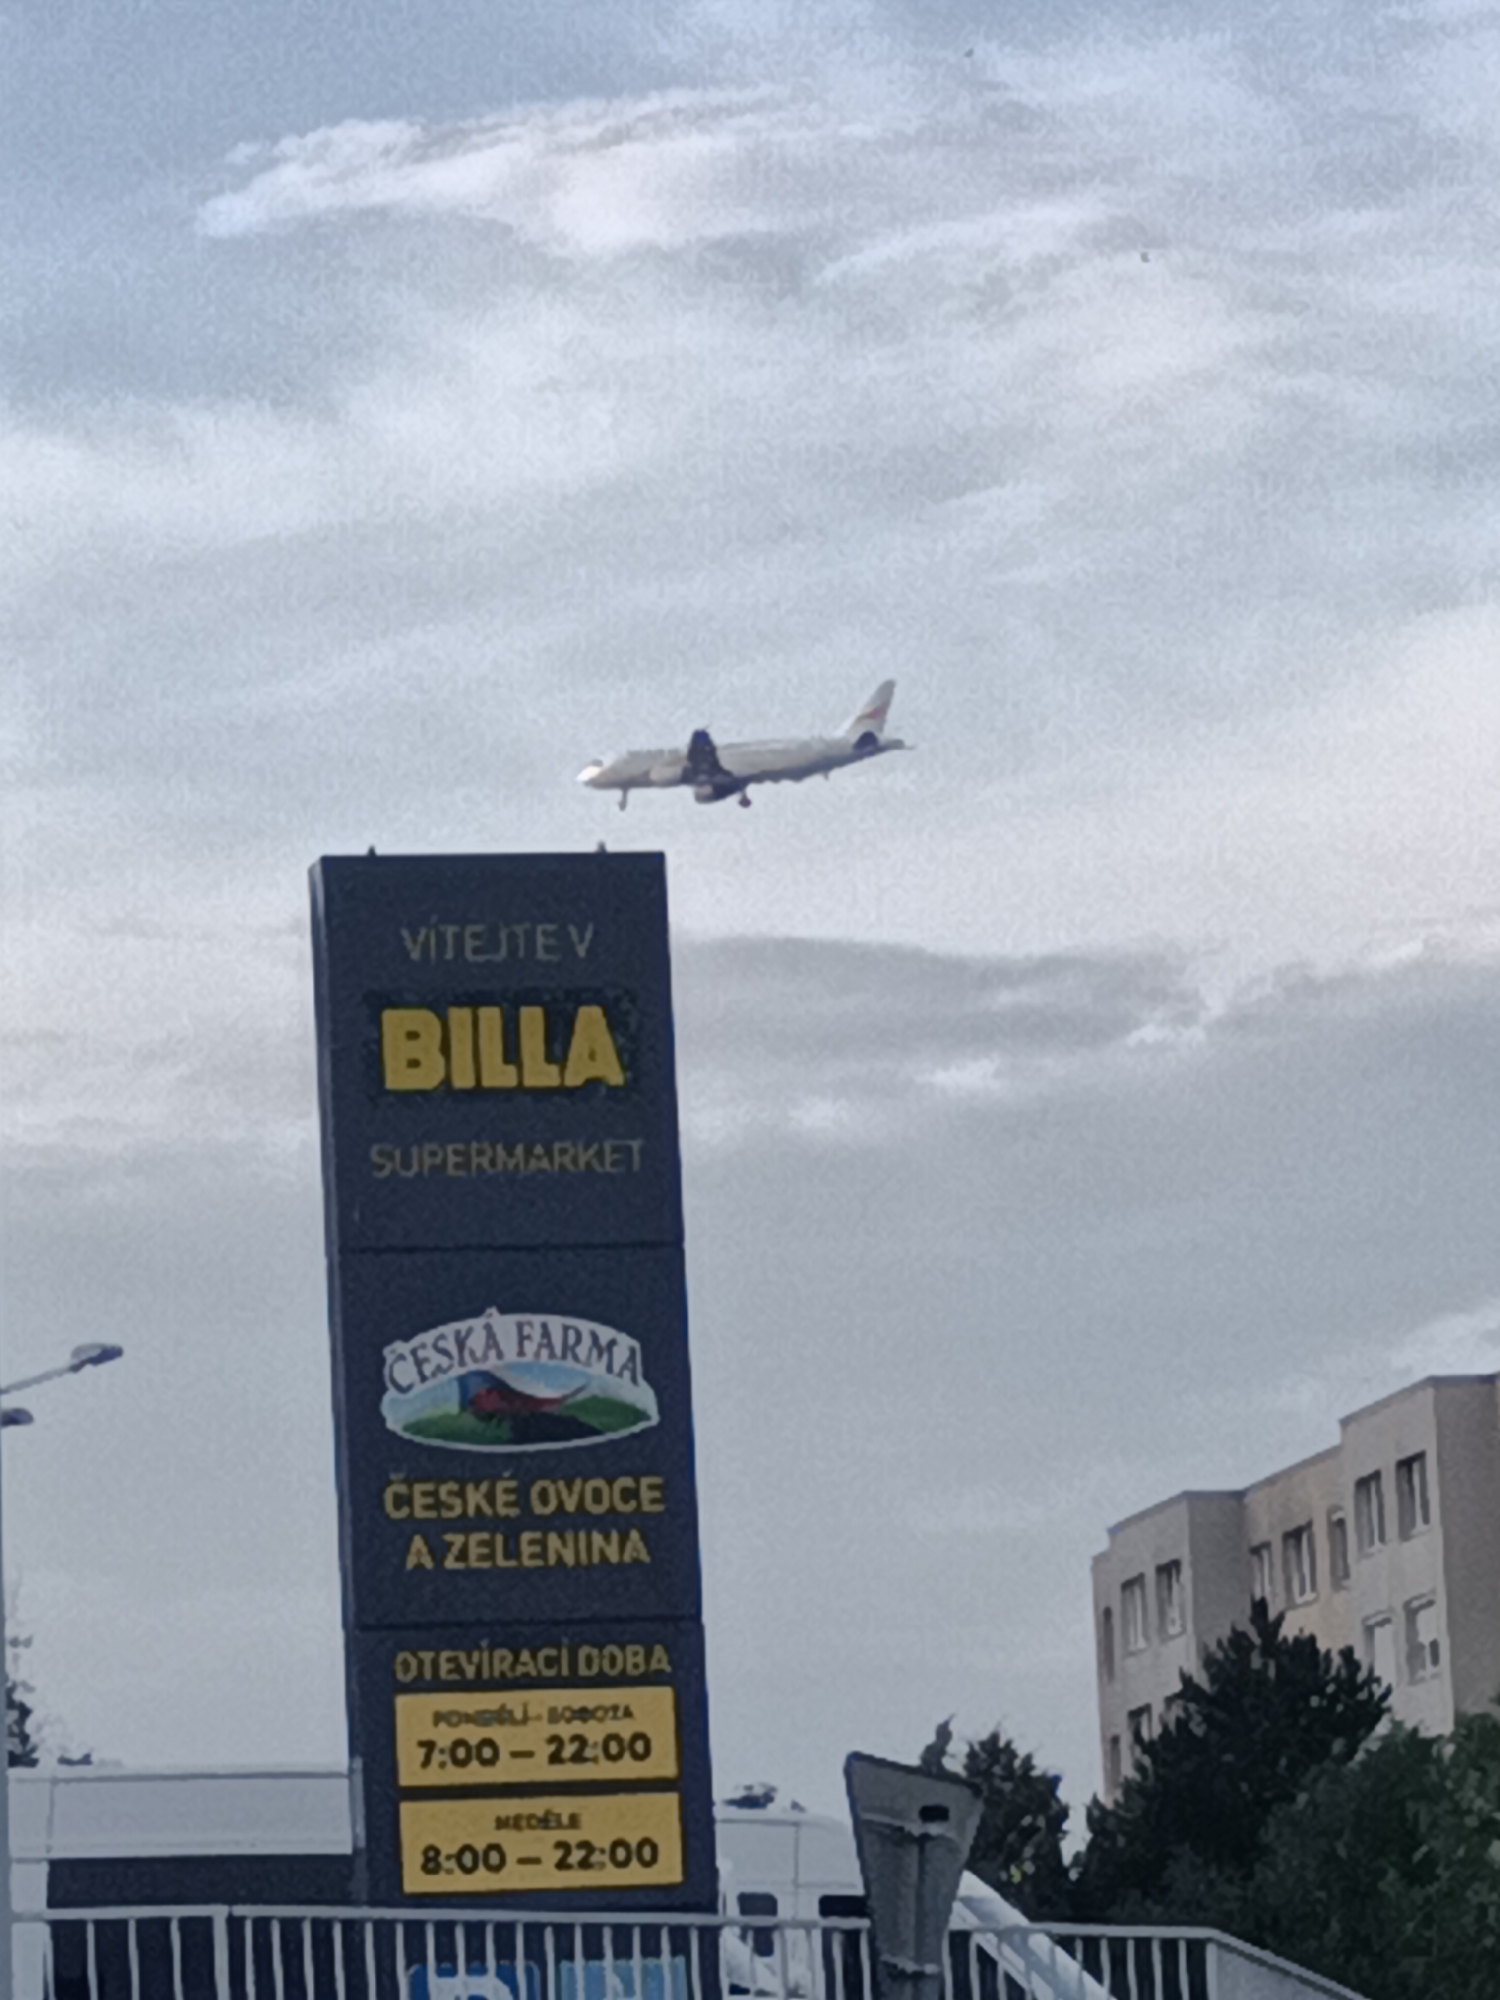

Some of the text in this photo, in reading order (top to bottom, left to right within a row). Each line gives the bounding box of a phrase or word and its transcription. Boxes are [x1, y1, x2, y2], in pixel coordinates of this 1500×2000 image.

[401, 914, 594, 962] VÍTEJTE V
[381, 1005, 626, 1090] BILLA
[370, 1138, 643, 1177] SUPERMARKET
[388, 1308, 640, 1394] ČESKÁ FARMA
[384, 1470, 665, 1519] ČESKÉ OVOCE
[405, 1529, 651, 1570] A ZELENINA
[395, 1637, 672, 1682] OTEVÍRACÍ DOBA
[416, 1737, 500, 1770] 7:00
[545, 1731, 652, 1766] 22:00
[420, 1843, 507, 1875] 8:00
[553, 1836, 659, 1872] 22:00
